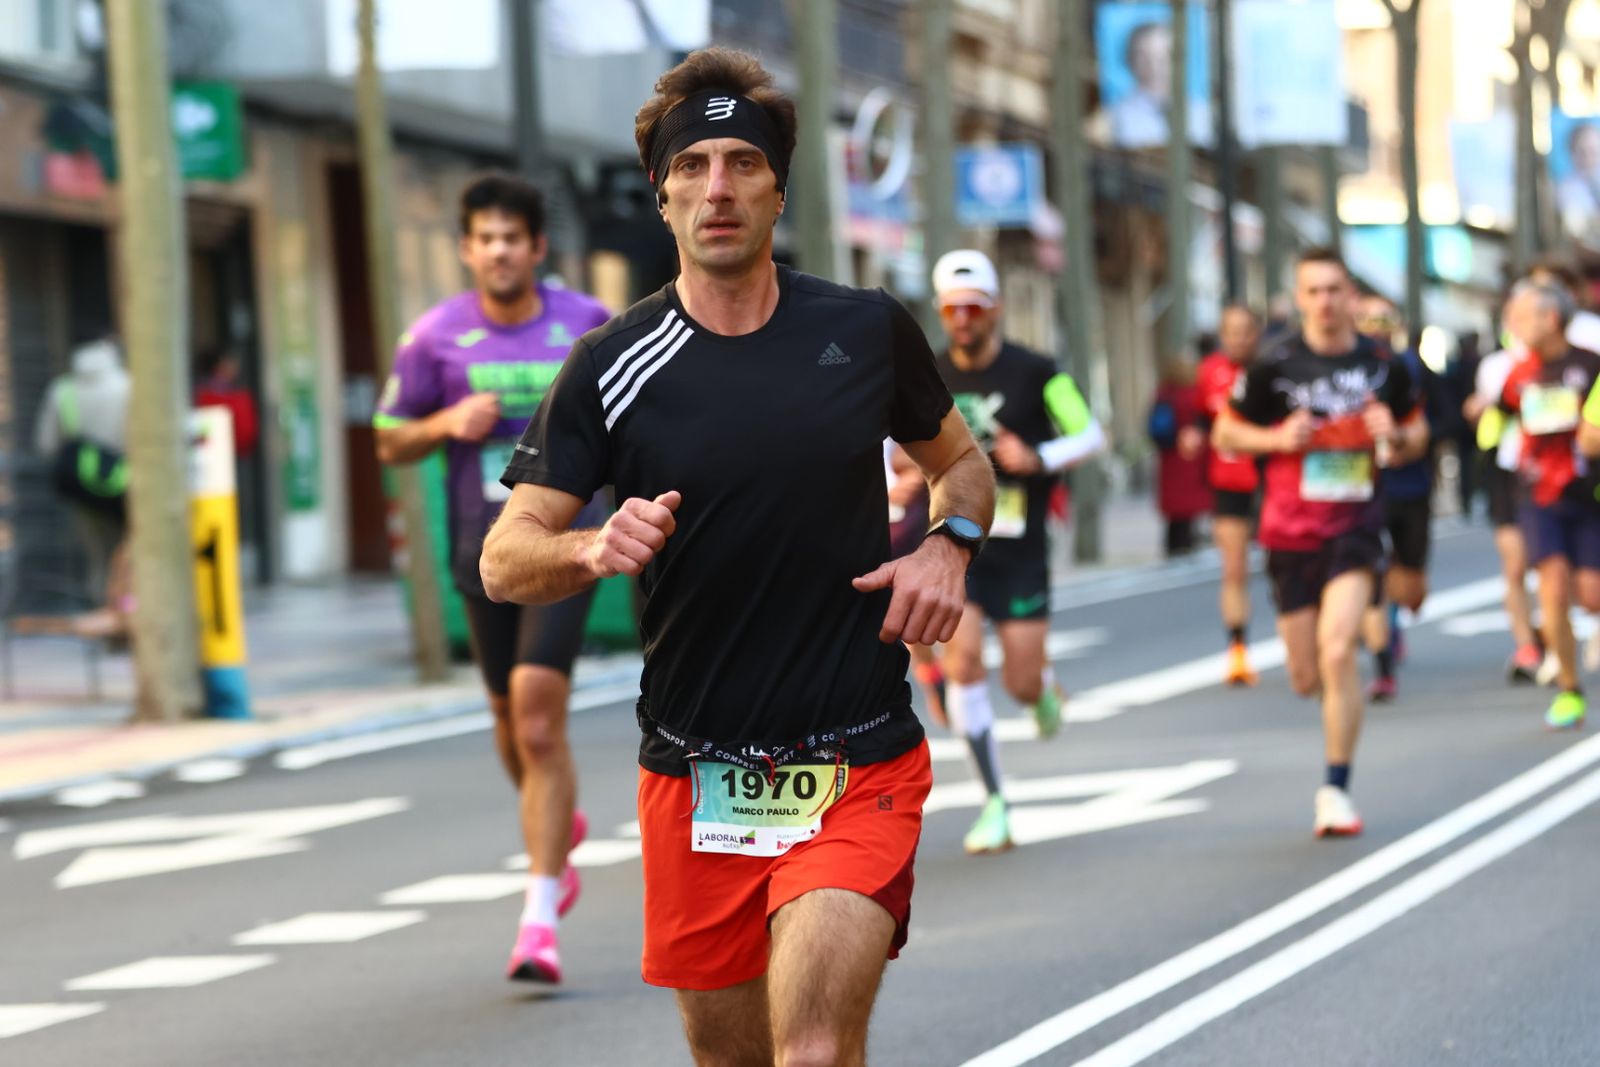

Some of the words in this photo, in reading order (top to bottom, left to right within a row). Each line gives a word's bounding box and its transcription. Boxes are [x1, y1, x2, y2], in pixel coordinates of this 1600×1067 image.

[818, 356, 851, 366] adidas
[721, 769, 817, 800] 1970
[732, 806, 764, 816] MARCO
[767, 807, 799, 816] PAULO
[699, 832, 738, 843] LABORAL
